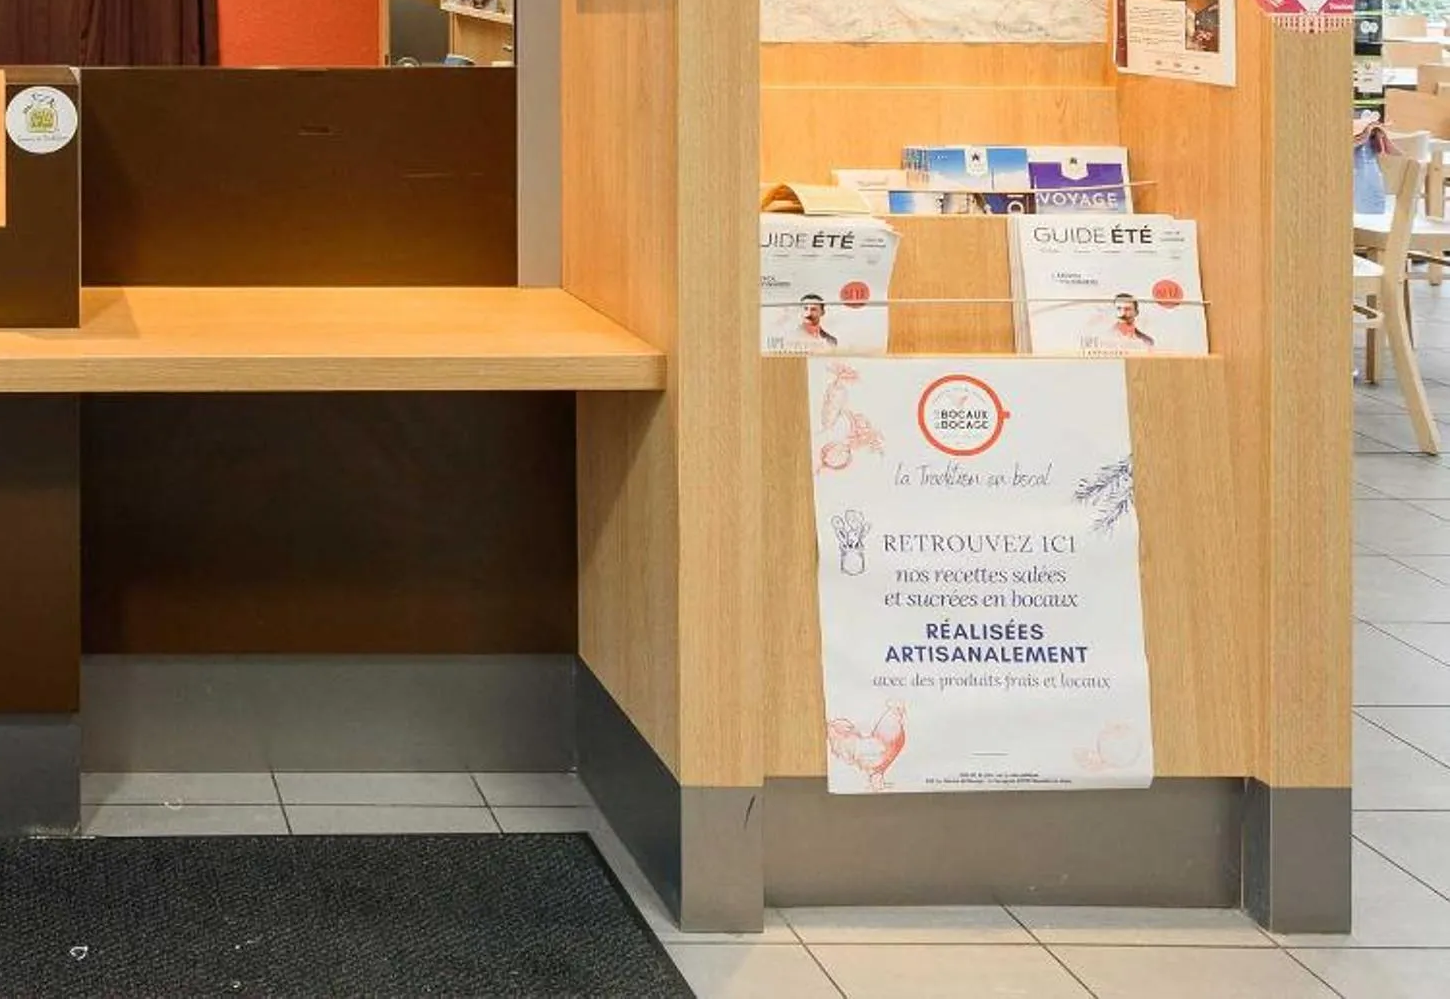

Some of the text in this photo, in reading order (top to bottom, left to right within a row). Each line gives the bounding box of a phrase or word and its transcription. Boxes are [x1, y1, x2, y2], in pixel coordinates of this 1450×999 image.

[1039, 192, 1118, 207] VOYAGE
[761, 230, 855, 249] UIDE ÉTÉ
[1034, 226, 1106, 245] GUIDE
[1111, 224, 1153, 244] ÉTÉ
[941, 410, 989, 419] BOCAUX
[941, 421, 989, 429] BOCAGE
[883, 534, 1076, 553] RETROUVEZ ICI
[896, 565, 1067, 583] nos recettes salées
[884, 589, 1078, 608] et sucrées en bocaux
[926, 618, 1044, 640] RÉALISÉES
[885, 646, 1088, 663] ARTISANALEMENT
[873, 673, 1111, 692] avec des produits frais et locaux
